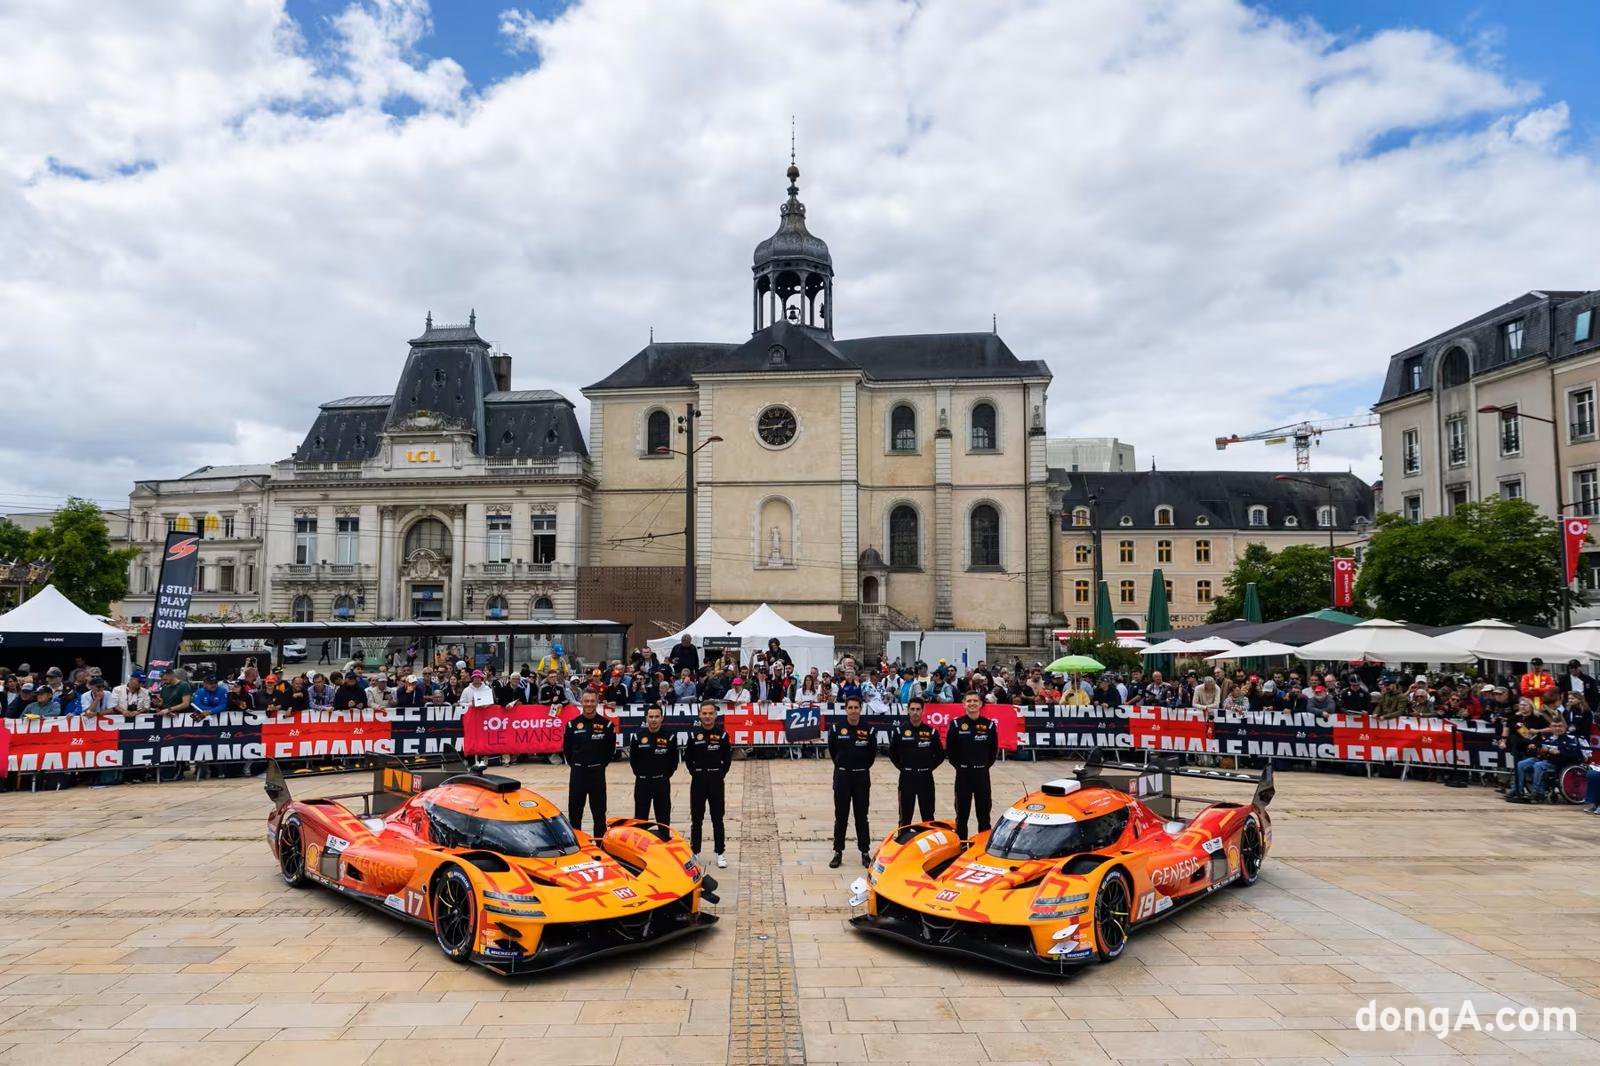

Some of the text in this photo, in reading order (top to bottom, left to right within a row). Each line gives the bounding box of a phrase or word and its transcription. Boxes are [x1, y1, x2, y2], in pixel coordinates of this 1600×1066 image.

[406, 449, 440, 462] LCL
[161, 595, 188, 606] PLAY
[158, 607, 187, 619] WITH
[1181, 614, 1206, 622] HOTE
[512, 717, 562, 730] course
[514, 728, 562, 744] MANS
[578, 866, 605, 882] 17
[1151, 856, 1201, 886] GENESIS
[615, 887, 635, 898] HY
[937, 890, 958, 900] HY
[407, 890, 424, 916] 17
[1137, 892, 1155, 919] 19
